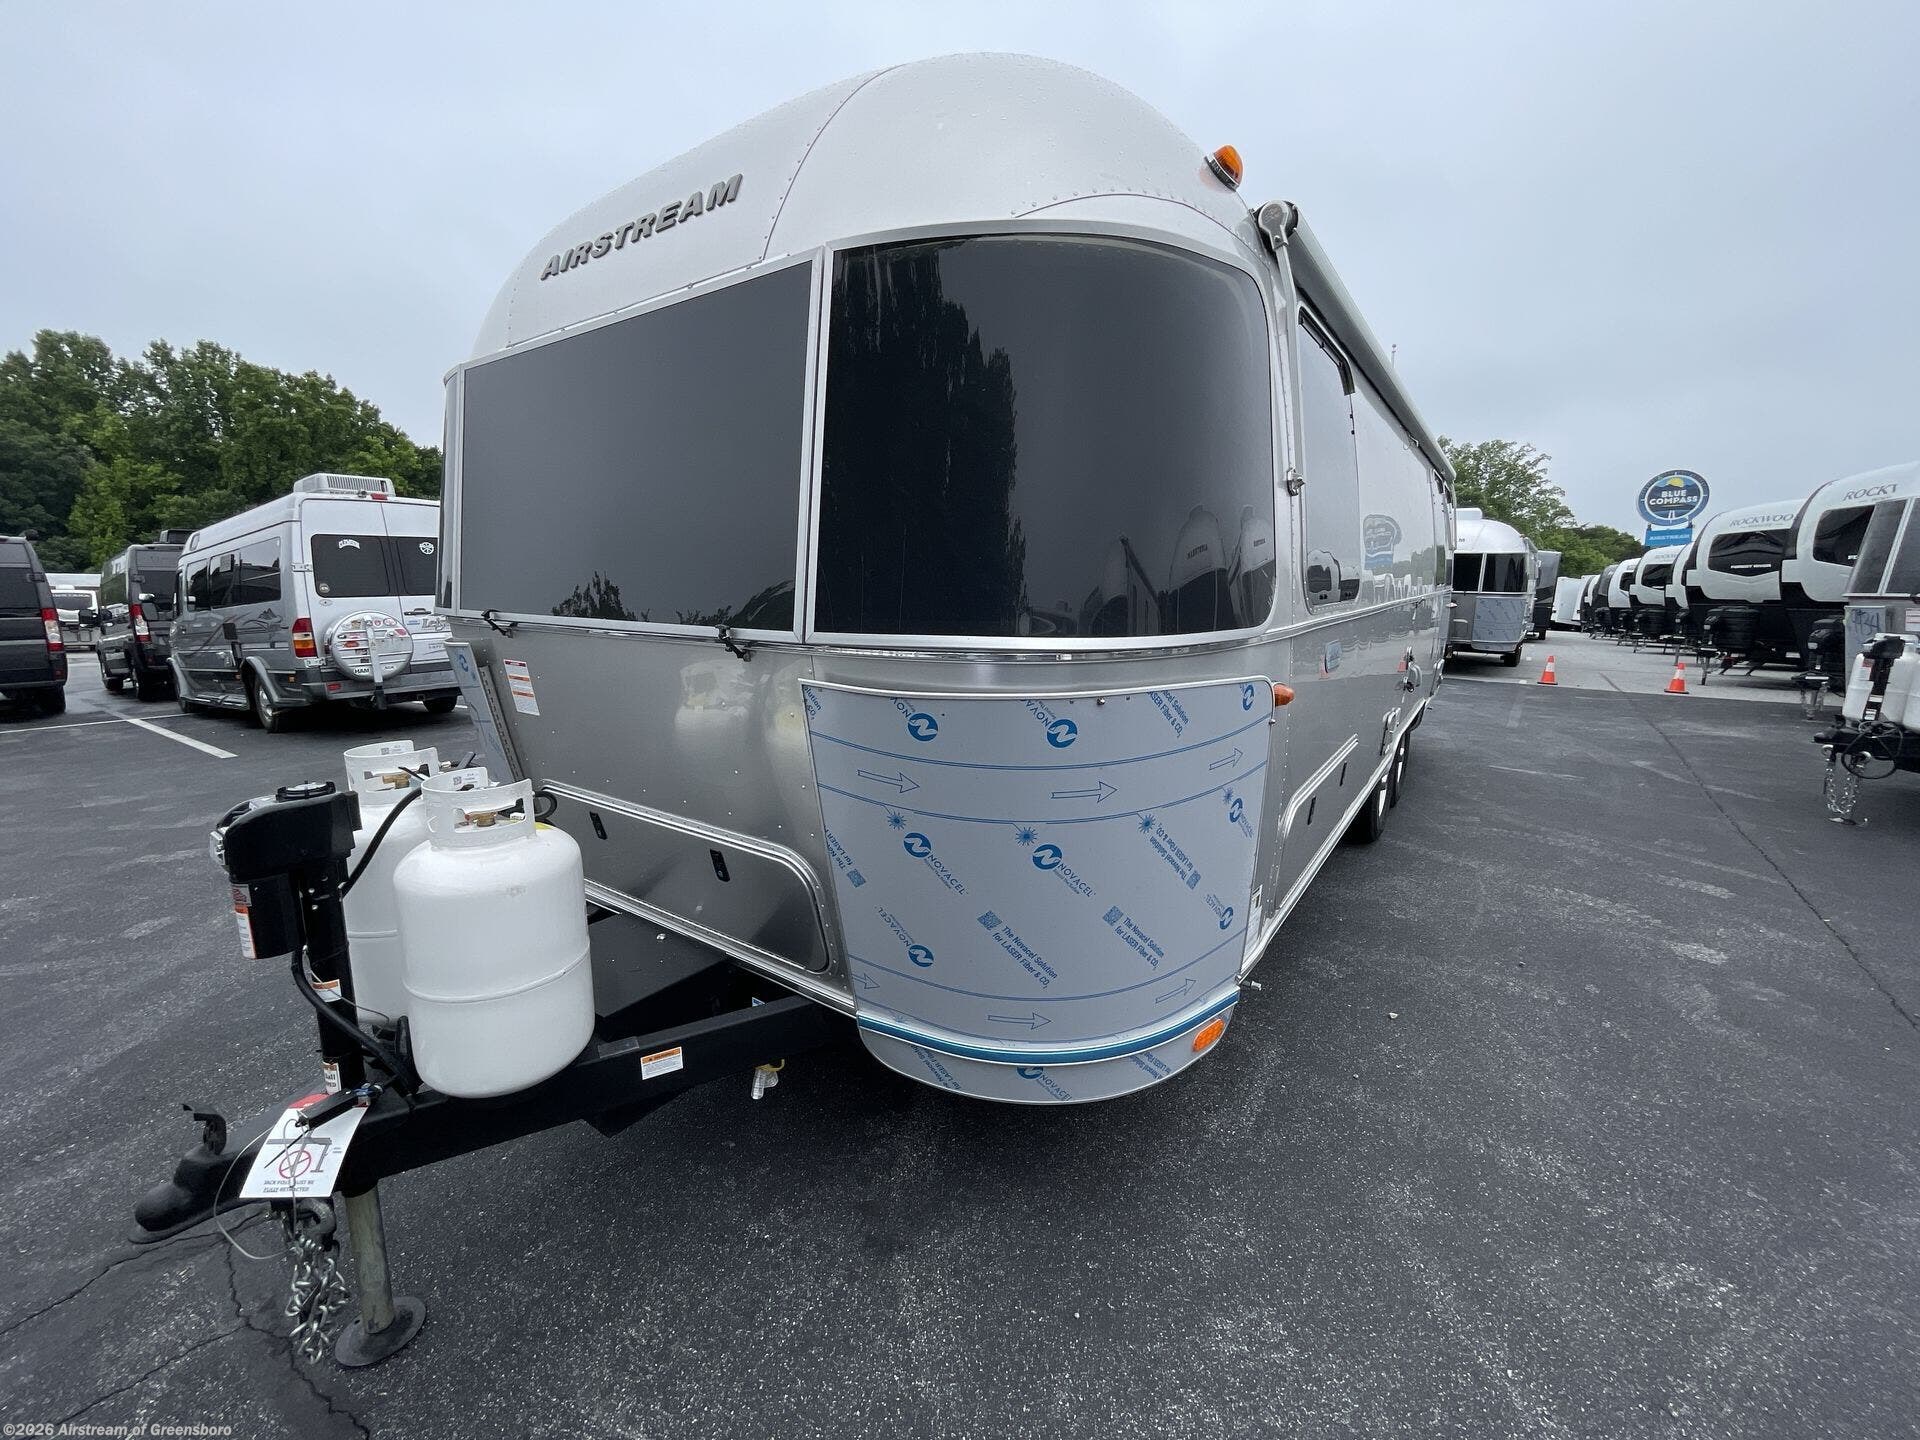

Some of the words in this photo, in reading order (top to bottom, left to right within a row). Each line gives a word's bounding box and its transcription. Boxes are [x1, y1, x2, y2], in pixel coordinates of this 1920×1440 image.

[540, 173, 743, 281] AIRSTREAM
[1649, 495, 1698, 505] COMPASS
[1661, 490, 1687, 498] BLUE
[1021, 699, 1052, 728] NOVA
[927, 854, 966, 895] NOVACEL
[1058, 863, 1093, 897] NOVACEL
[878, 906, 911, 947] NOVACEL
[1114, 925, 1123, 935] for
[1121, 931, 1139, 950] LASER
[1136, 946, 1148, 960] Fiber
[1123, 917, 1134, 929] The
[1131, 924, 1151, 943] Novacel
[1147, 939, 1165, 958] Solution
[992, 932, 1003, 943] for
[1001, 940, 1022, 961] LASER
[1020, 958, 1036, 976] Fiber
[1034, 971, 1041, 979] &
[1002, 926, 1014, 939] The
[1012, 935, 1037, 959] Novacel
[1034, 955, 1058, 980] Solution
